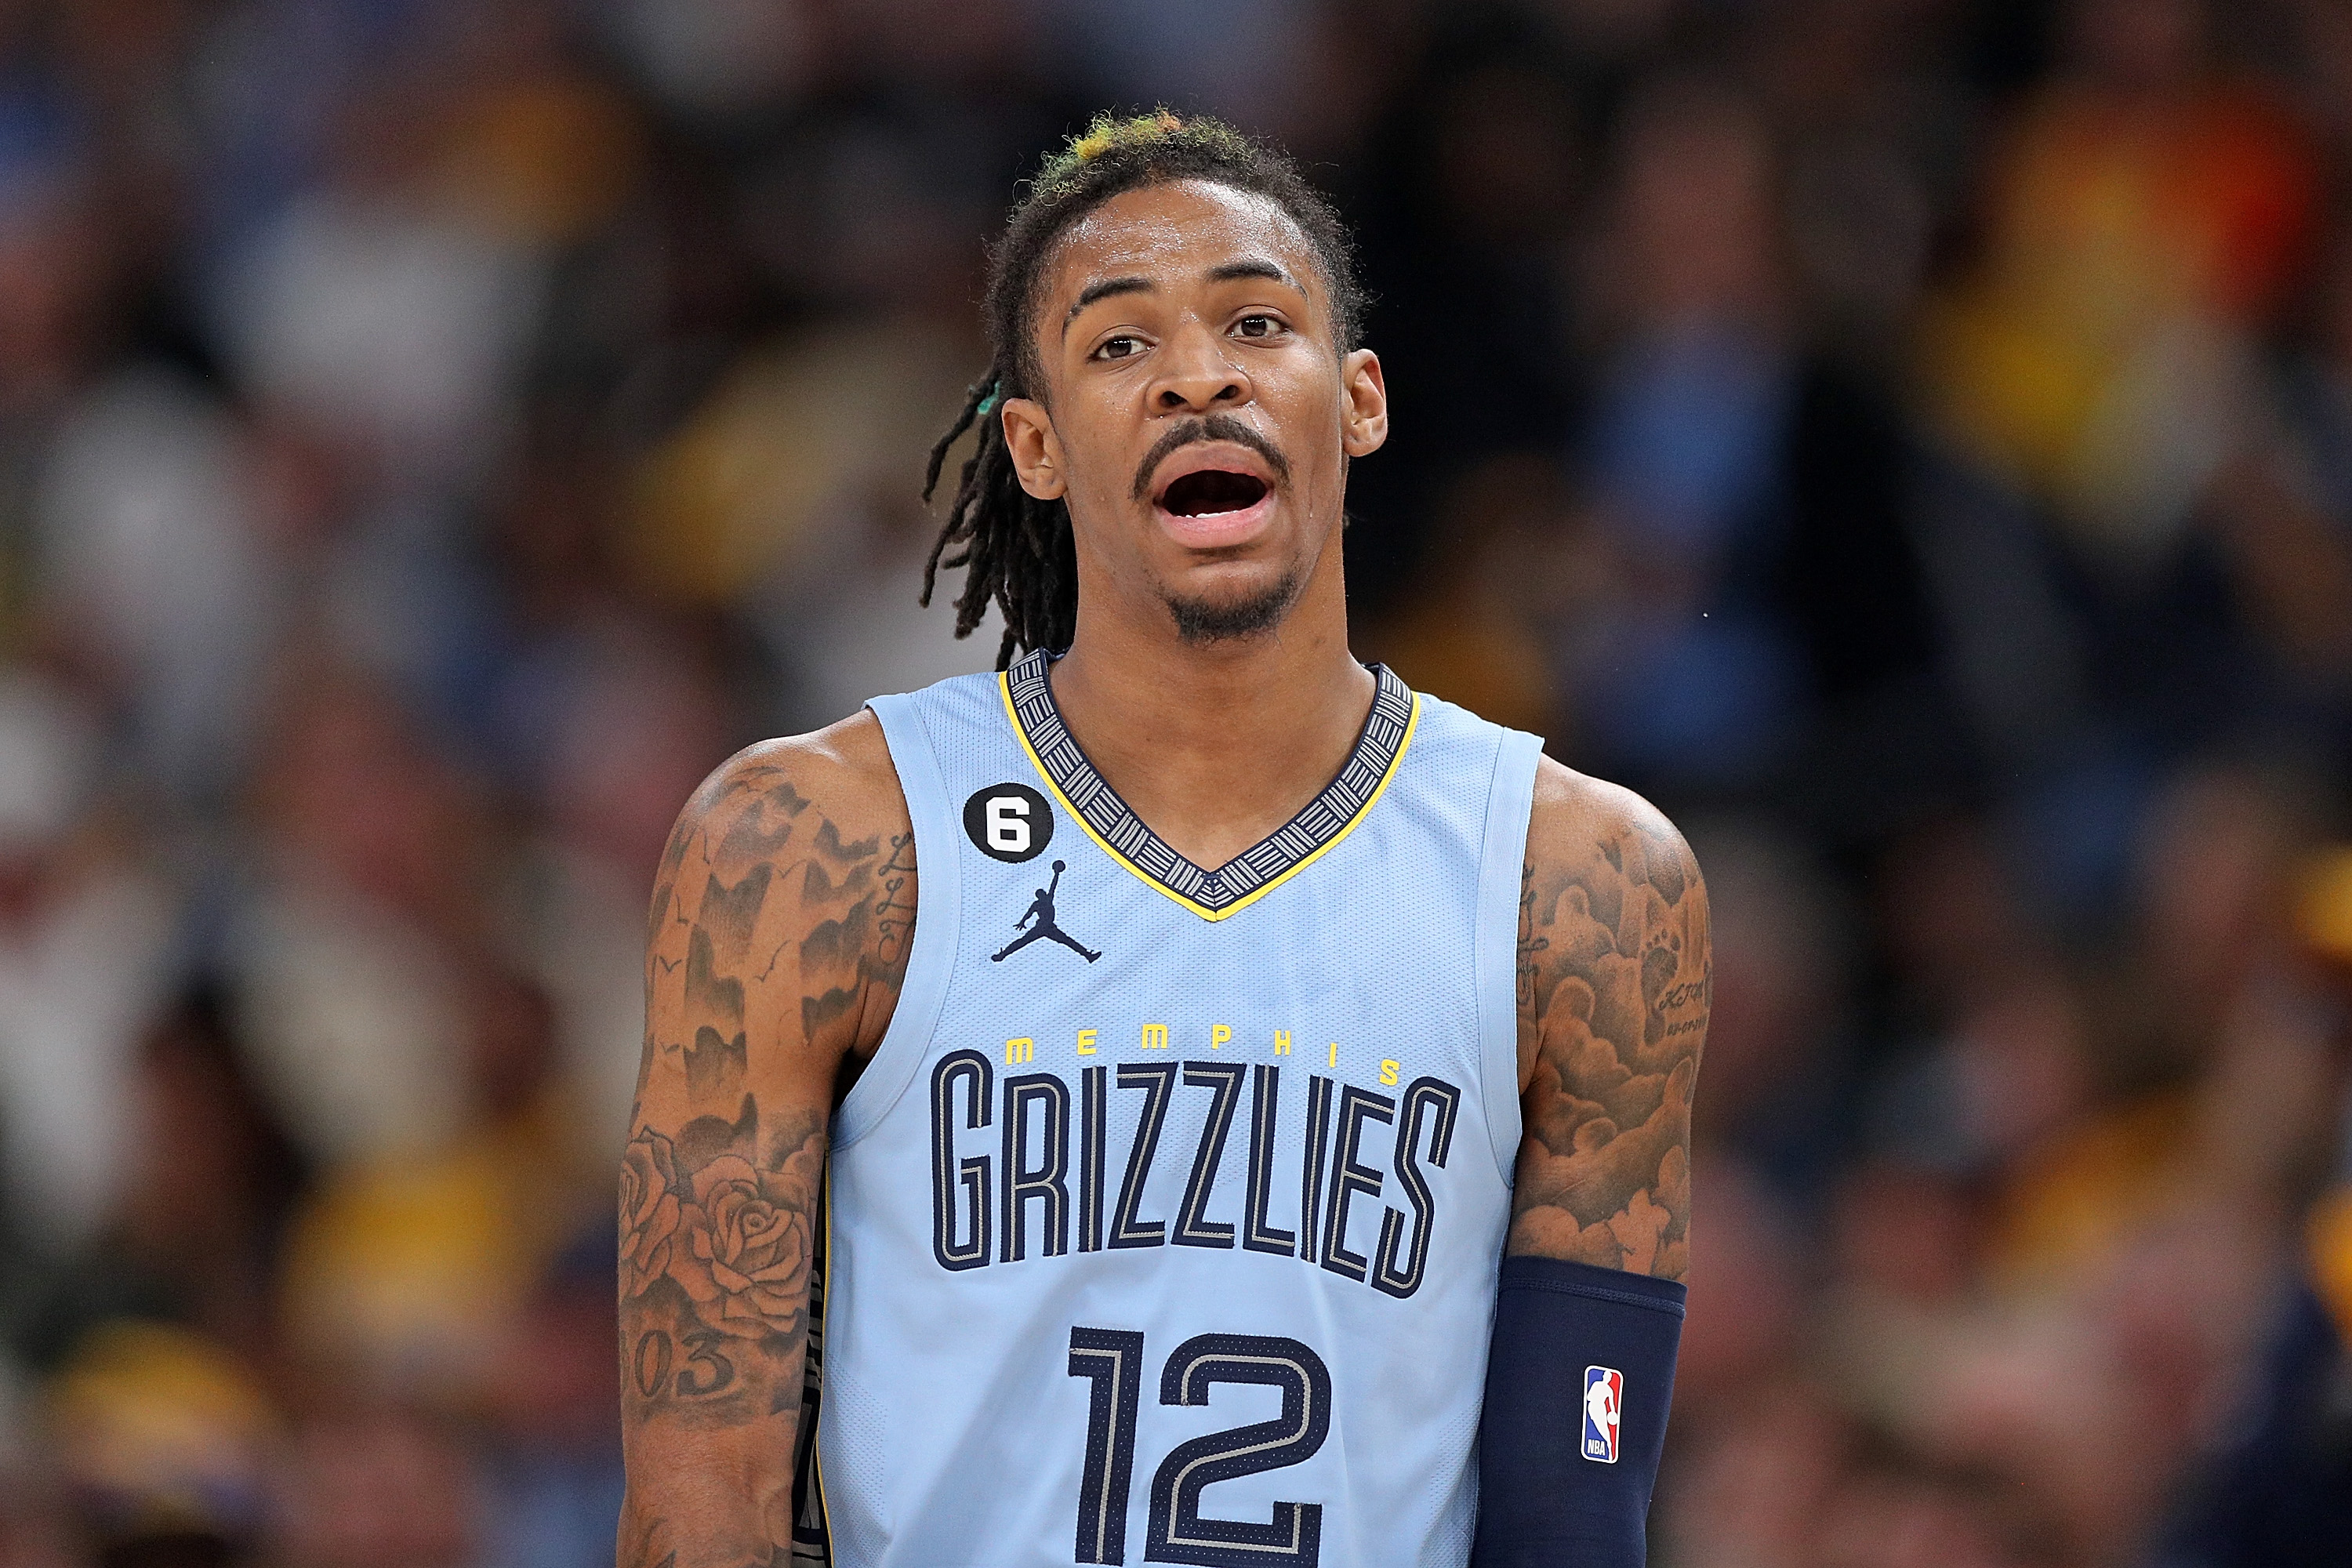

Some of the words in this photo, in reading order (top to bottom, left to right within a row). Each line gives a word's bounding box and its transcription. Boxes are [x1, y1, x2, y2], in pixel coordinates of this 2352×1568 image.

[985, 796, 1031, 853] 6
[1005, 1023, 1400, 1087] MEMPHIS
[931, 1048, 1461, 1300] GRIZZLIES
[634, 1330, 735, 1399] 03
[1068, 1326, 1332, 1568] 12
[1587, 1439, 1606, 1457] NBA
